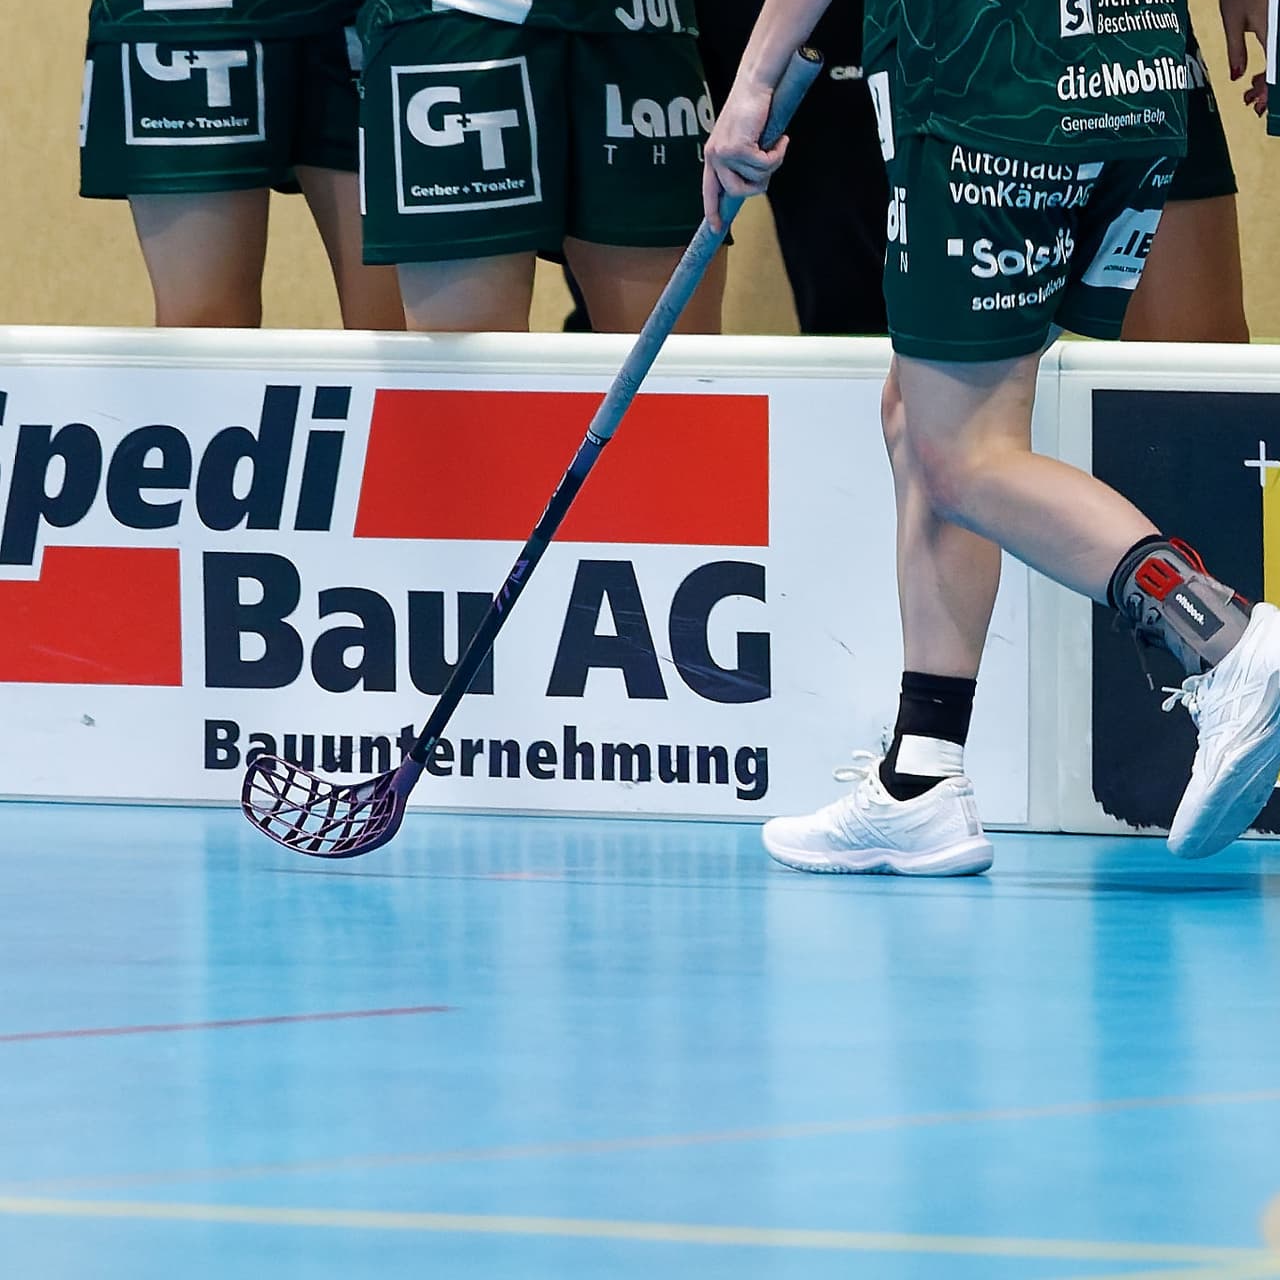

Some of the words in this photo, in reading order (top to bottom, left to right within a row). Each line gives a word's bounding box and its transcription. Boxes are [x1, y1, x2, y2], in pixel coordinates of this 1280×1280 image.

[1097, 9, 1180, 35] Beschriftung
[140, 117, 185, 130] Gerber
[196, 117, 250, 129] Troxler
[410, 183, 460, 198] Gerber
[472, 178, 526, 194] Troxler
[0, 383, 352, 566] pedi
[202, 550, 495, 697] Bau
[545, 559, 772, 705] AG
